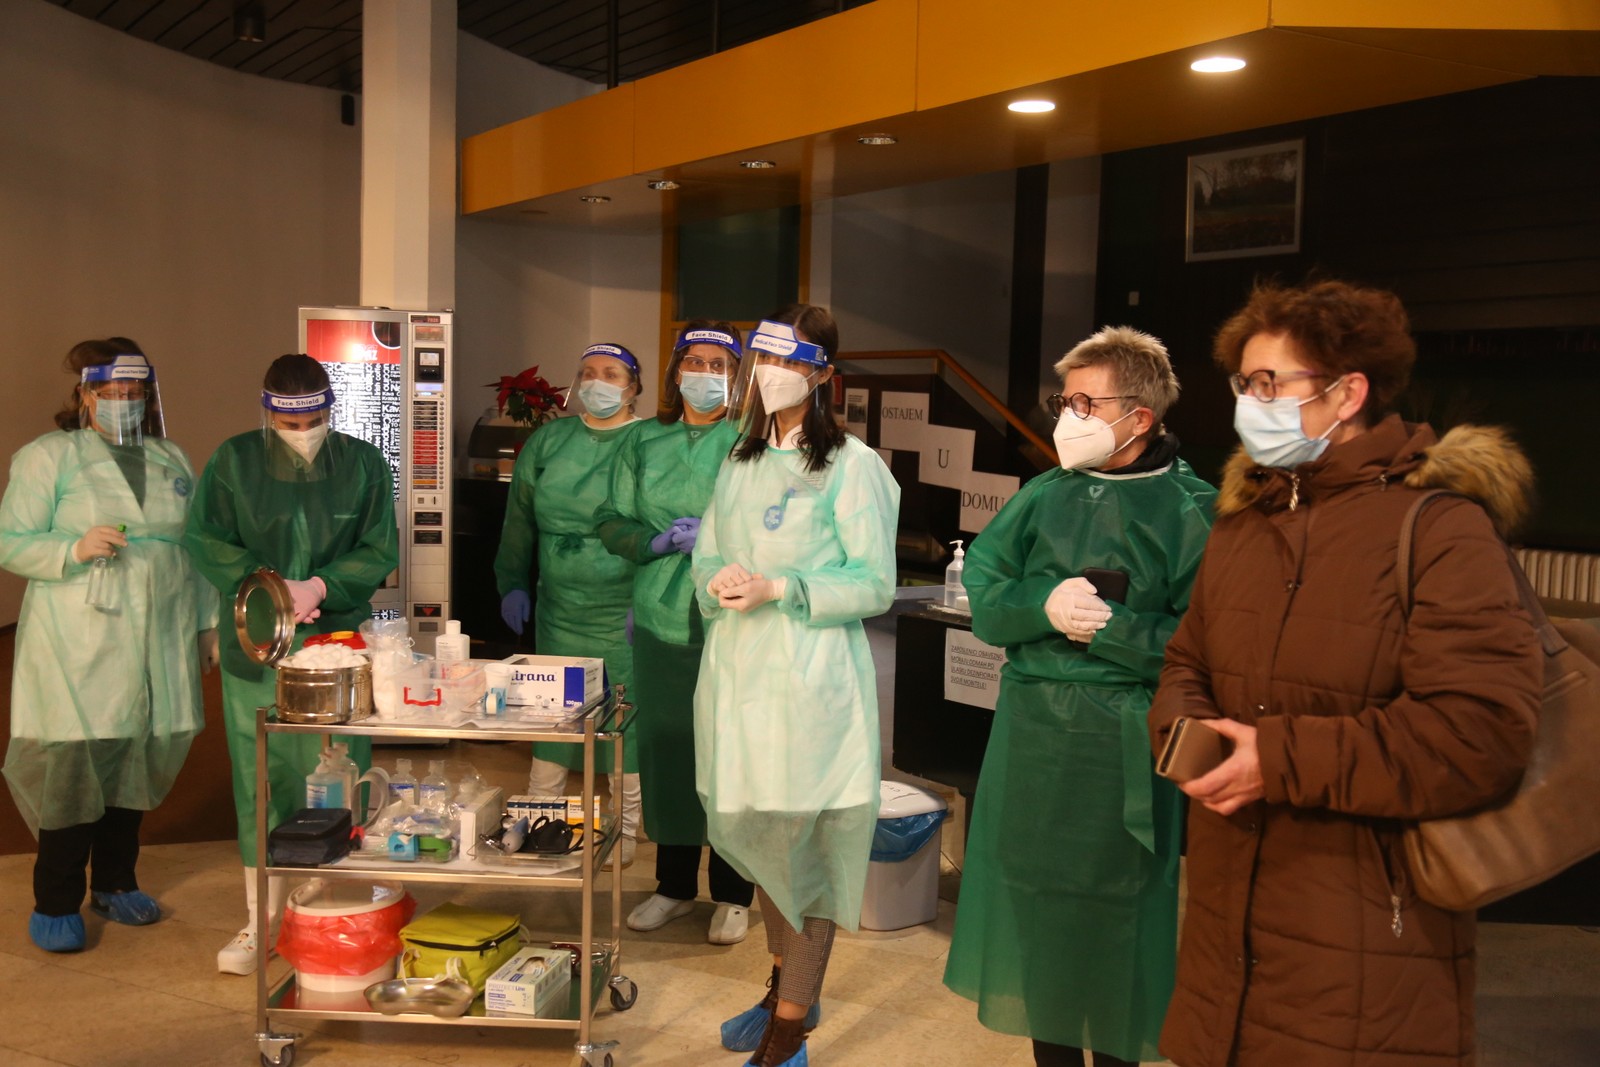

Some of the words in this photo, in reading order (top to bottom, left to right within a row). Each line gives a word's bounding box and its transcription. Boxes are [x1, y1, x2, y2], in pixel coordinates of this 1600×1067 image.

[708, 332, 728, 341] Shield
[778, 343, 793, 351] Shield
[277, 399, 294, 407] Face
[295, 398, 320, 406] Shield
[882, 406, 923, 420] OSTAJEM
[938, 448, 950, 469] U
[962, 491, 1005, 512] DOMU
